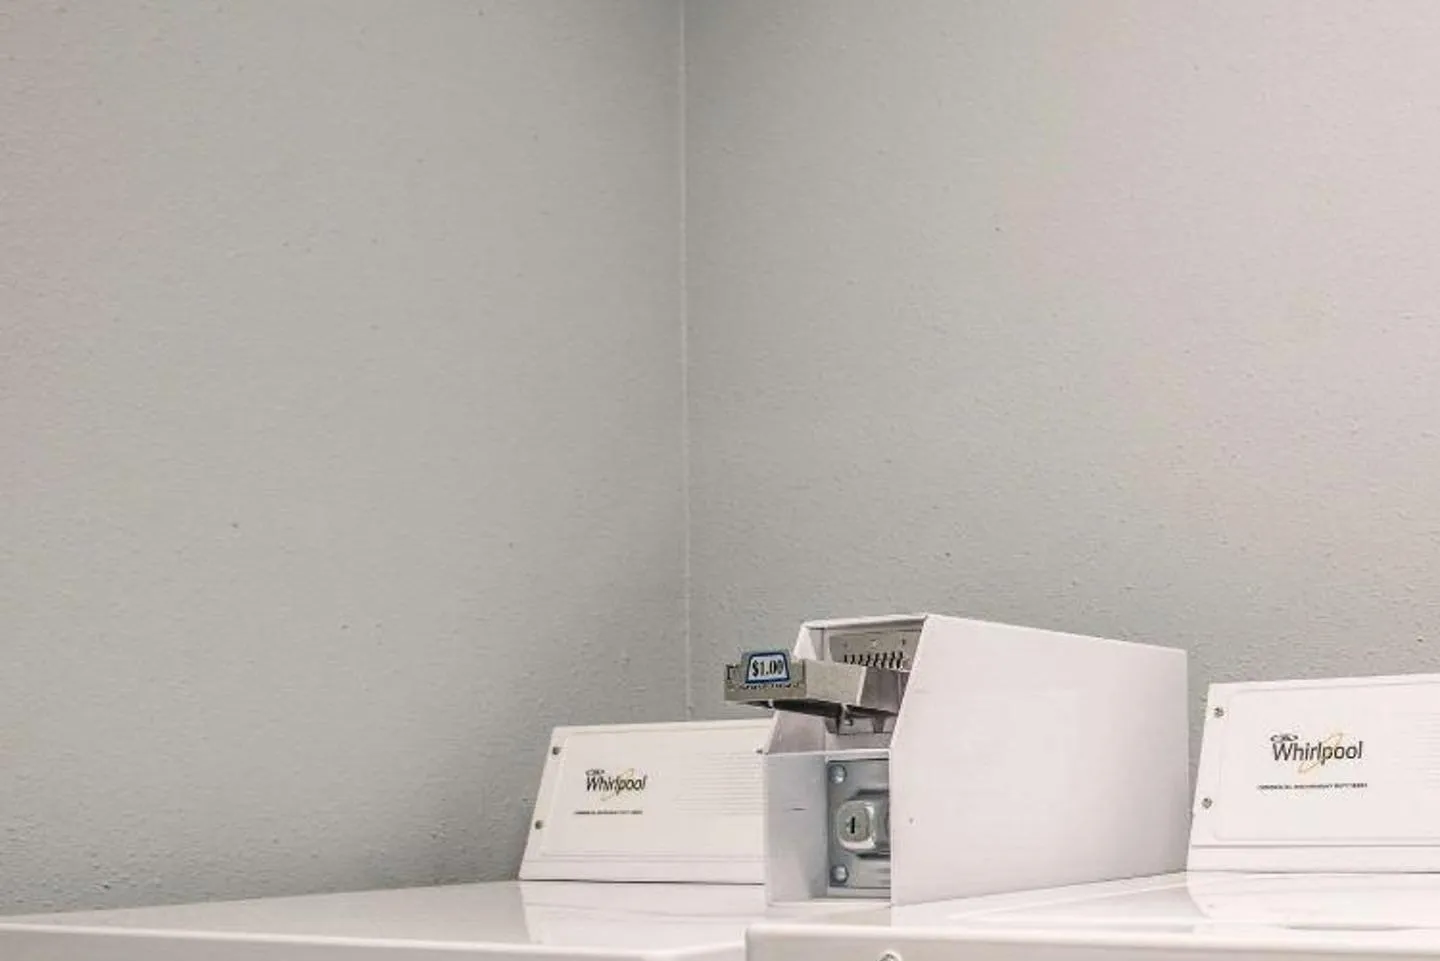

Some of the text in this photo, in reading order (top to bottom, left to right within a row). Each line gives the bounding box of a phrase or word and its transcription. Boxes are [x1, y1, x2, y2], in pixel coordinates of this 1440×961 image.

[751, 658, 784, 678] $1.00
[1272, 740, 1364, 766] Whirlpool
[586, 774, 648, 797] Whirlpool
